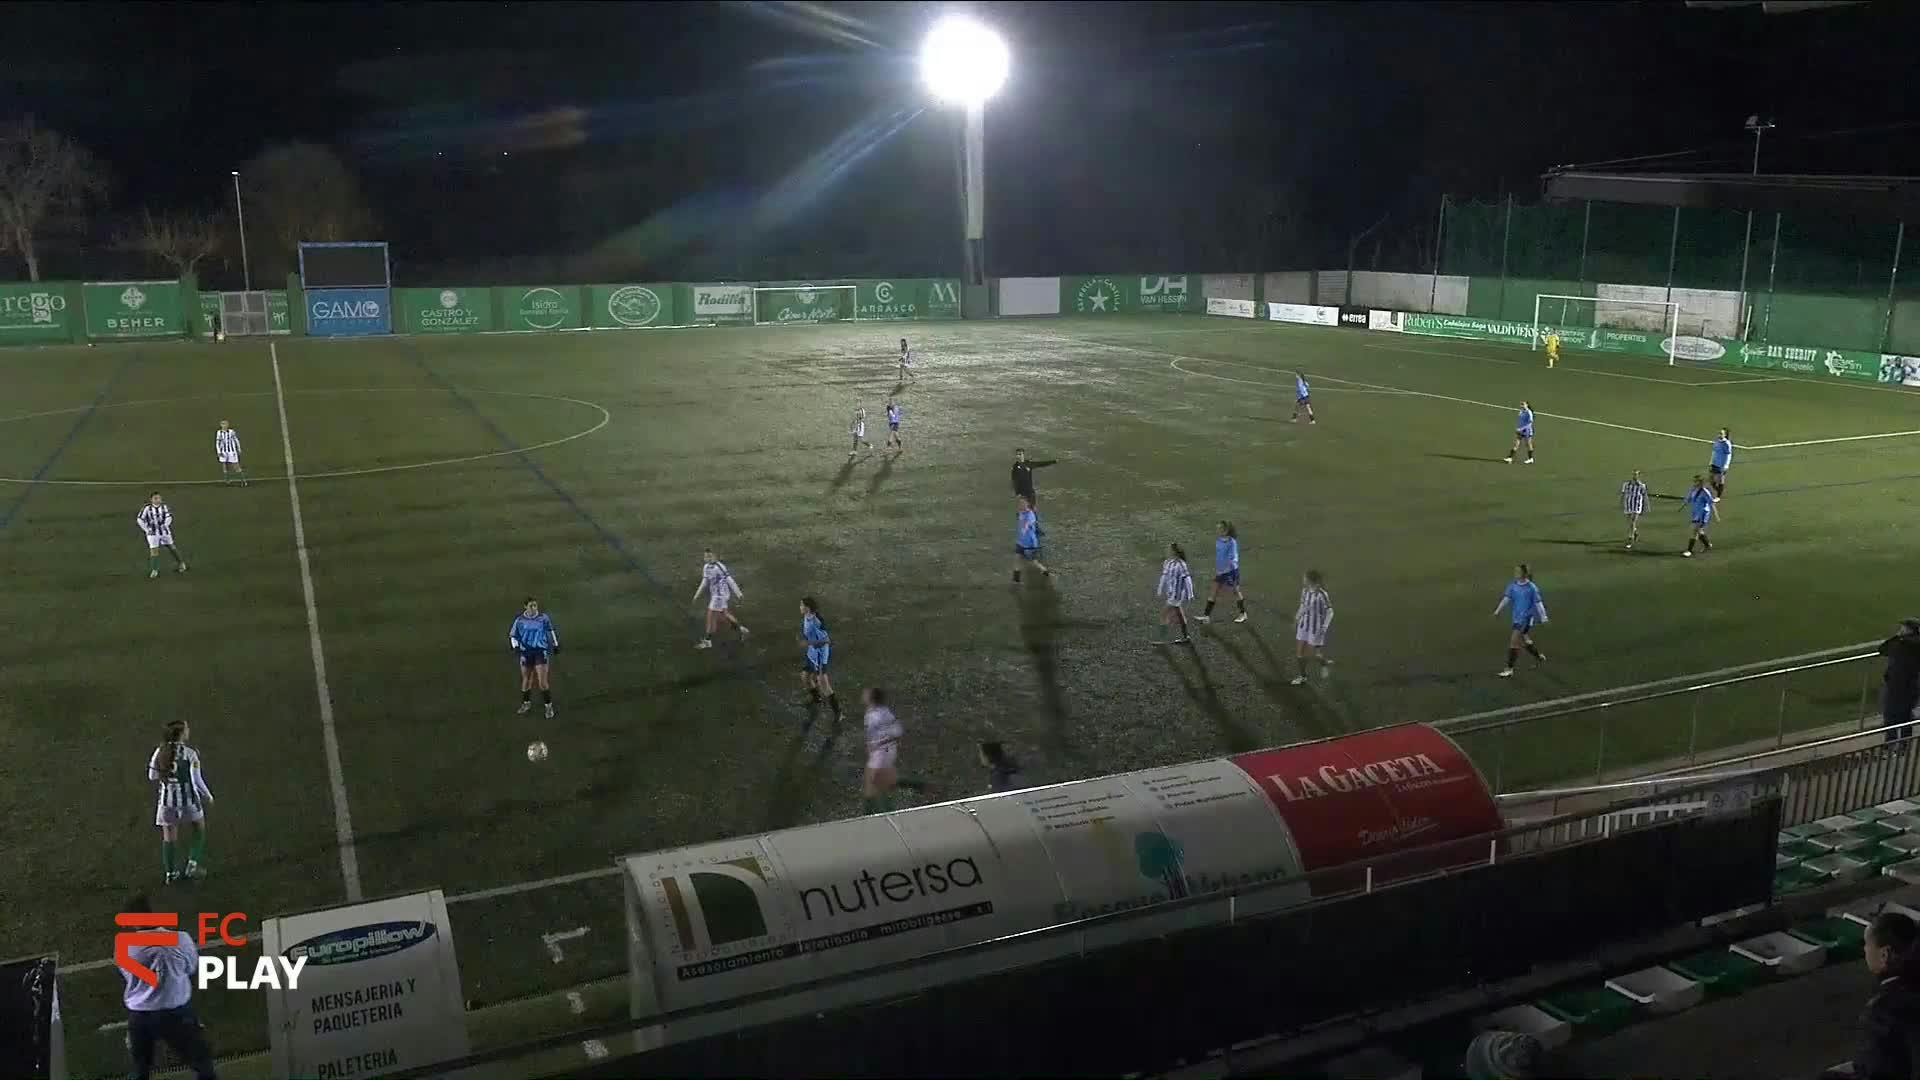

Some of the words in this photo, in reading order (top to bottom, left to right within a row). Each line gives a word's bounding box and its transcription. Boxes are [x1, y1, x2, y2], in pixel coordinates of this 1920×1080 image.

[0, 293, 66, 322] rego
[421, 309, 464, 318] CASTRO
[106, 317, 166, 328] BEHER
[798, 856, 984, 921] nutersa
[289, 920, 426, 961] Europillow
[407, 977, 416, 993] Y
